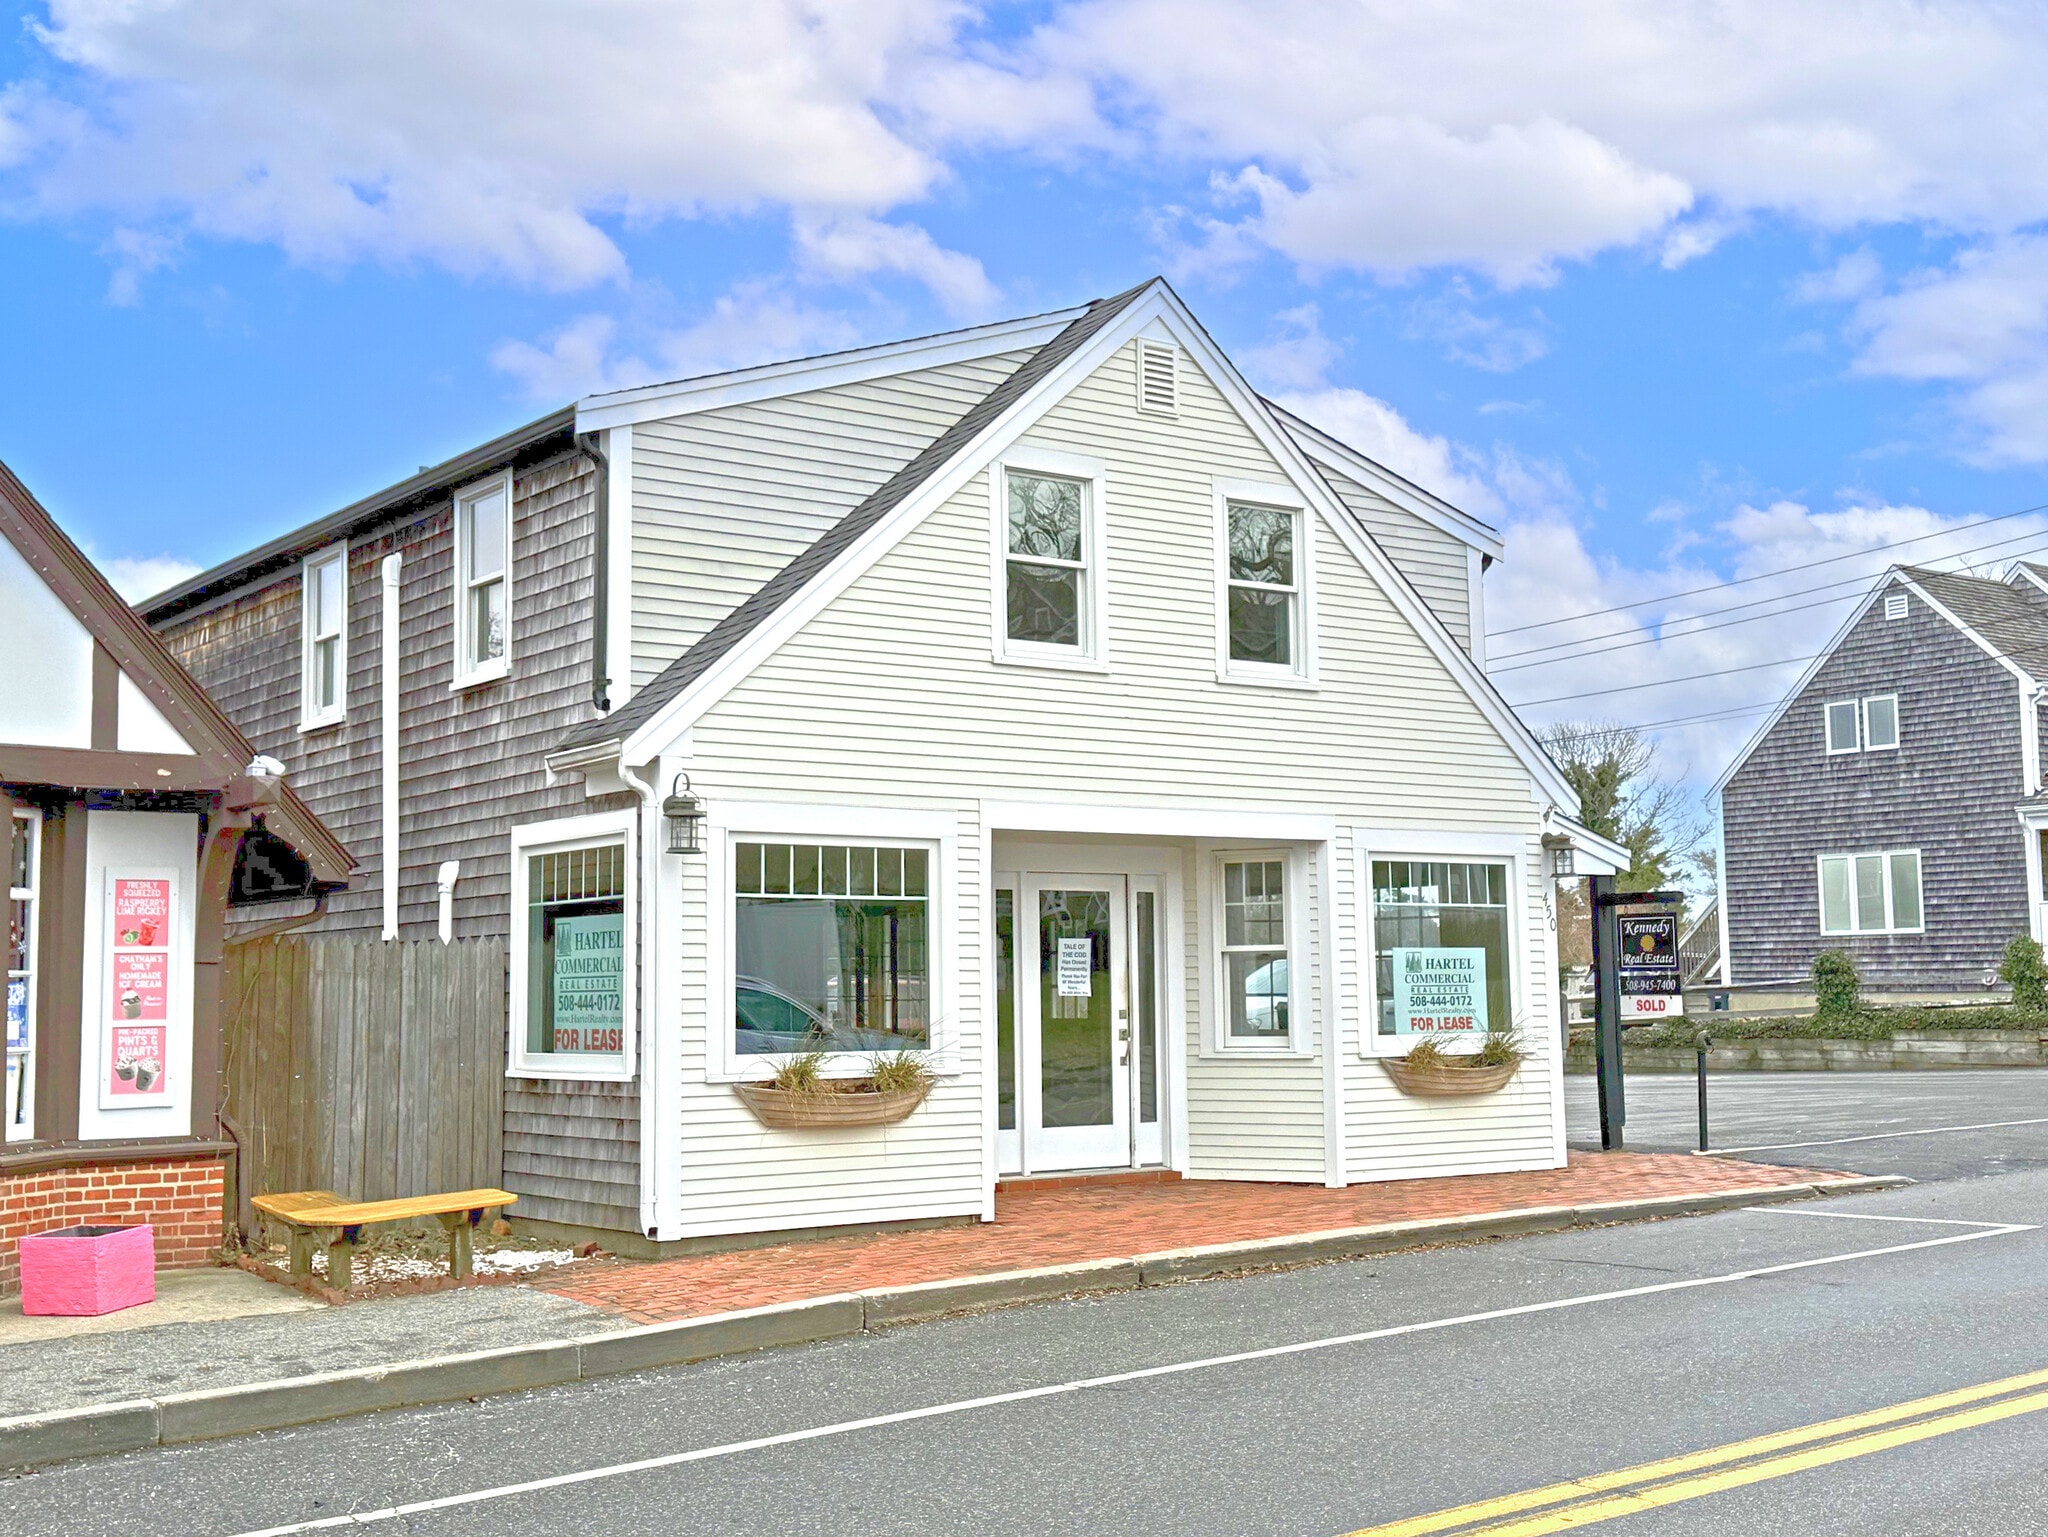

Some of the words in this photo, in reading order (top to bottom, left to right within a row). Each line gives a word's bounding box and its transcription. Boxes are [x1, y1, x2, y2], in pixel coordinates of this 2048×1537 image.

[126, 881, 158, 889] FRESHLY
[124, 889, 160, 897] SQUEEZED
[118, 898, 166, 908] RASPBERRY
[116, 906, 136, 916] LIME
[1542, 892, 1556, 932] 450
[1624, 920, 1670, 936] Kennedy
[575, 930, 624, 950] HARTEL
[119, 955, 162, 963] CHATHAM'S
[1425, 958, 1474, 969] HARTEL
[1624, 952, 1644, 965] Real
[1645, 953, 1674, 964] Estate
[554, 956, 624, 974] COMMERCIAL
[560, 980, 581, 990] REAL
[585, 978, 618, 989] ESTATE
[1404, 974, 1475, 984] COMMERCIAL
[1625, 980, 1676, 991] 508-945-7400
[558, 994, 620, 1012] 508-444-0172
[1410, 996, 1472, 1006] 508-444-0172
[1636, 1000, 1666, 1012] SOLD
[1410, 1017, 1434, 1030] FOR
[1438, 1016, 1473, 1030] LEASE
[118, 1036, 147, 1046] PINTS
[151, 1035, 157, 1045] &
[554, 1029, 580, 1050] FOR
[584, 1028, 624, 1051] LEASE
[117, 1046, 159, 1057] QUARTS
